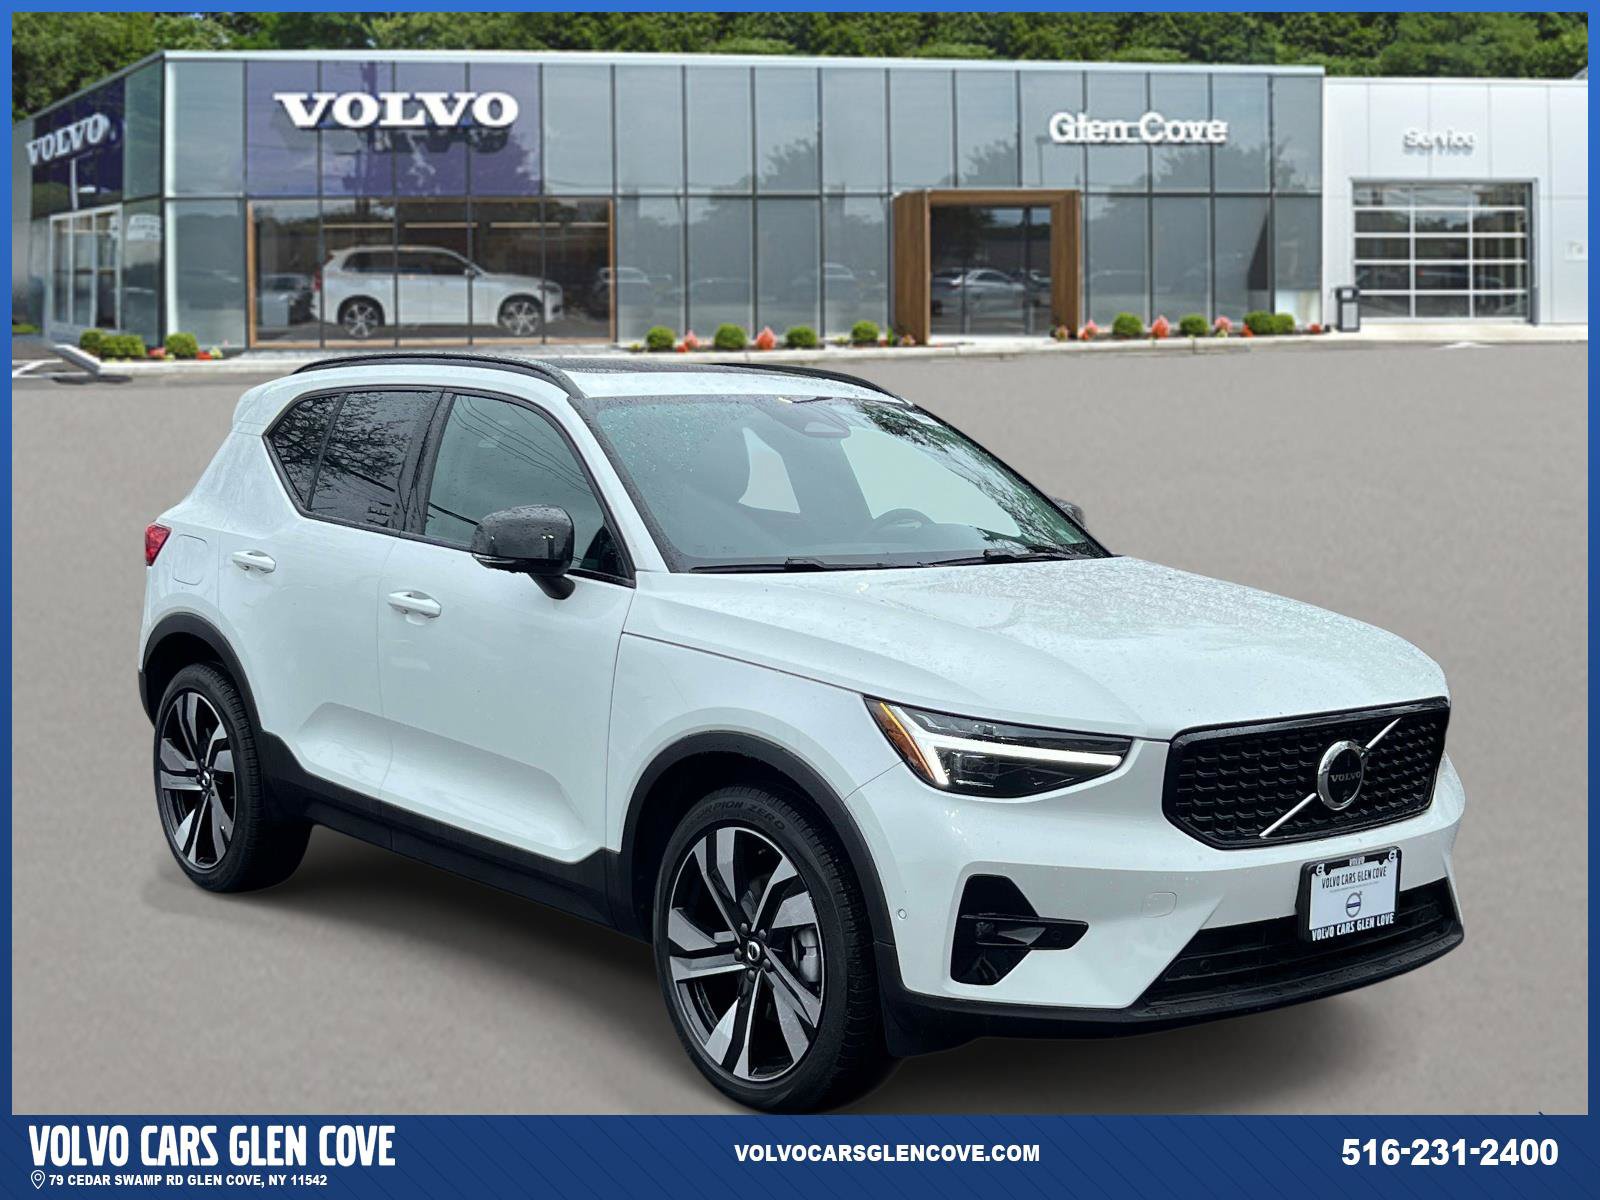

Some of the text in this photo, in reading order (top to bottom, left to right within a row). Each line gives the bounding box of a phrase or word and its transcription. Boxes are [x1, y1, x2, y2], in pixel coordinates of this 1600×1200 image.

[273, 92, 518, 127] VOLVO
[25, 113, 110, 165] VOLVO
[1049, 111, 1229, 143] Glen Cove
[1403, 128, 1477, 153] Service
[1329, 771, 1361, 783] VOLVO
[748, 803, 786, 830] ZERO
[1321, 875, 1340, 889] VOLVO
[1341, 871, 1356, 885] CARS
[1357, 869, 1372, 882] GLEN
[1372, 866, 1387, 879] COVE
[1312, 926, 1335, 941] VOLVO
[1336, 921, 1355, 936] CARS
[1356, 916, 1375, 931] GLEN
